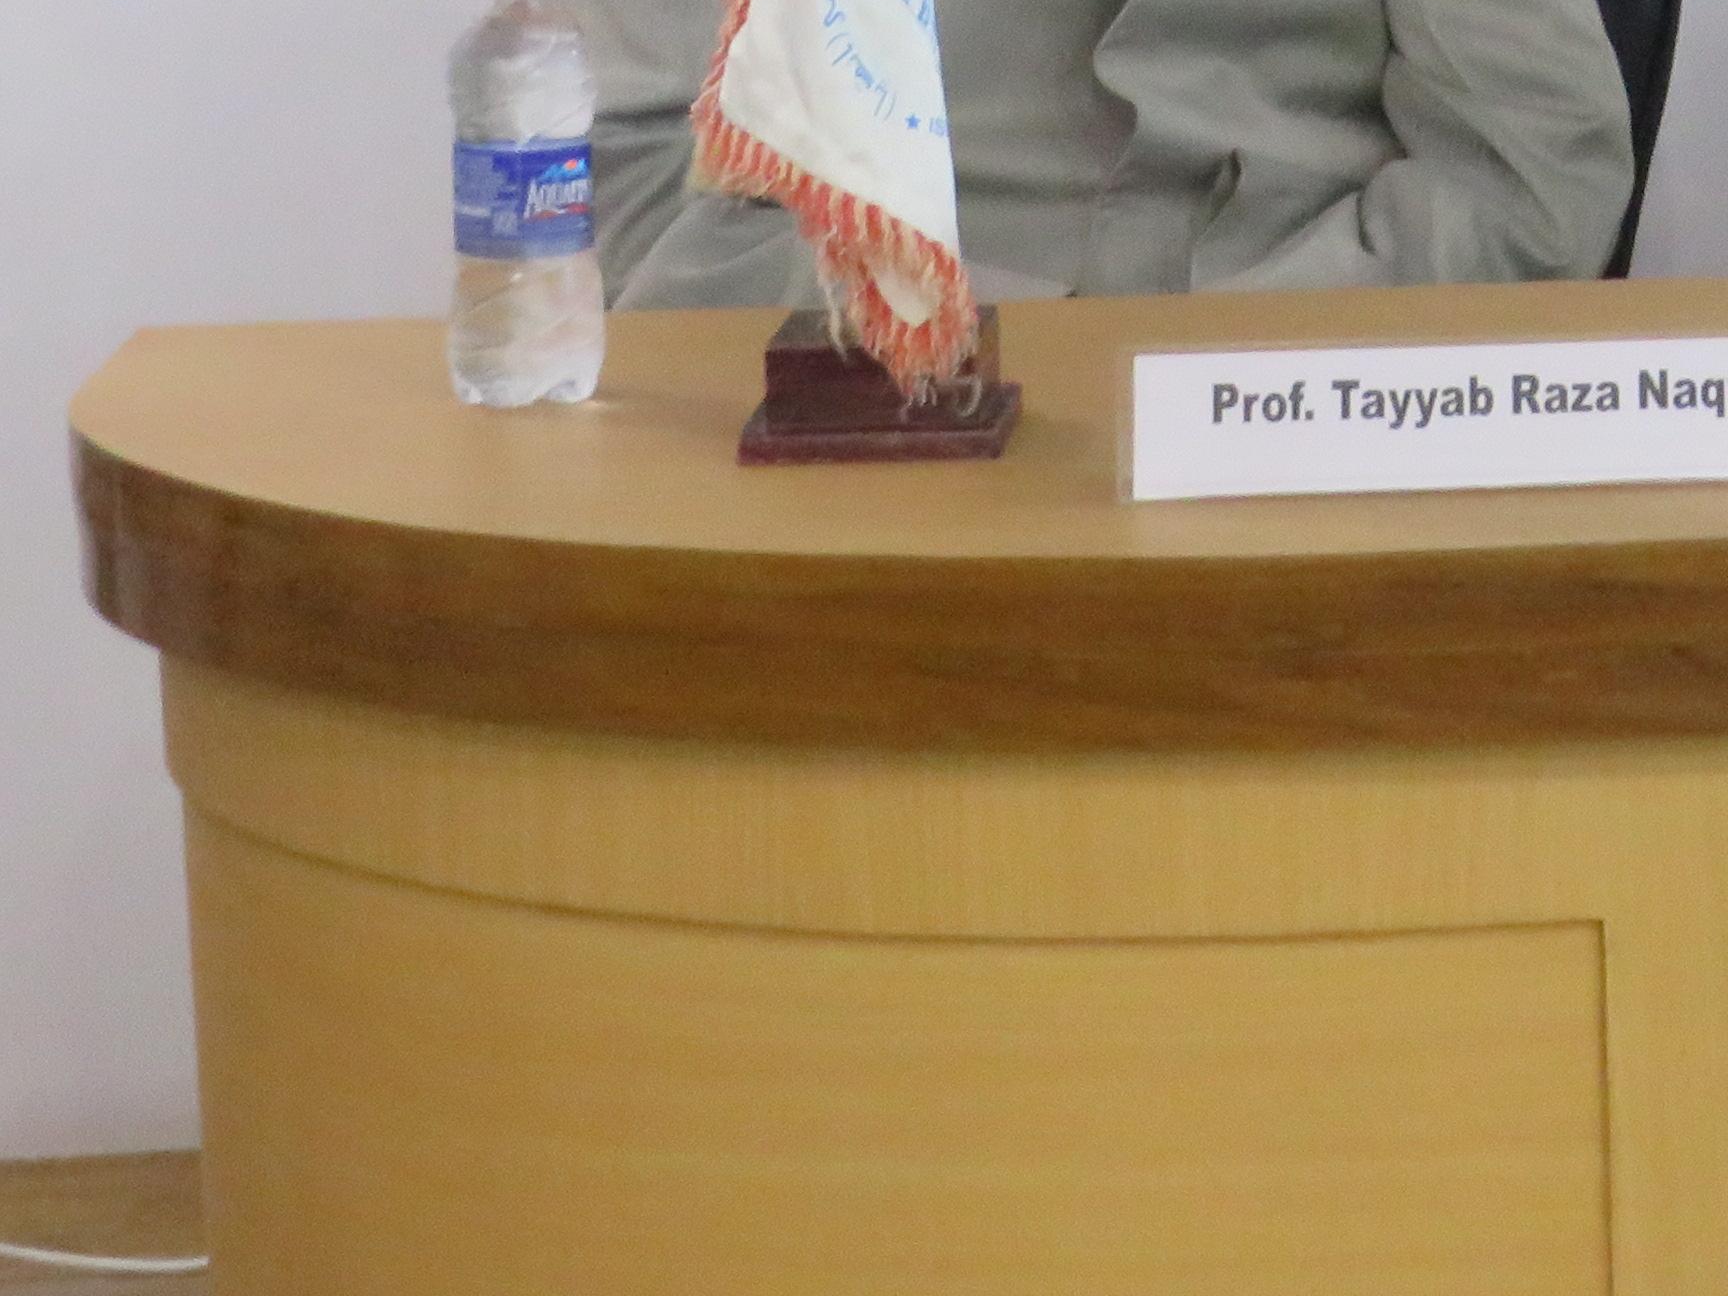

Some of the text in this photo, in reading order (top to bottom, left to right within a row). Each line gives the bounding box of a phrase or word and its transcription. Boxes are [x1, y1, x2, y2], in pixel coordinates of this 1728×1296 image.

[1211, 381, 1315, 426] Prof.
[1330, 374, 1495, 429] Tayyab
[1510, 373, 1621, 416] Raza
